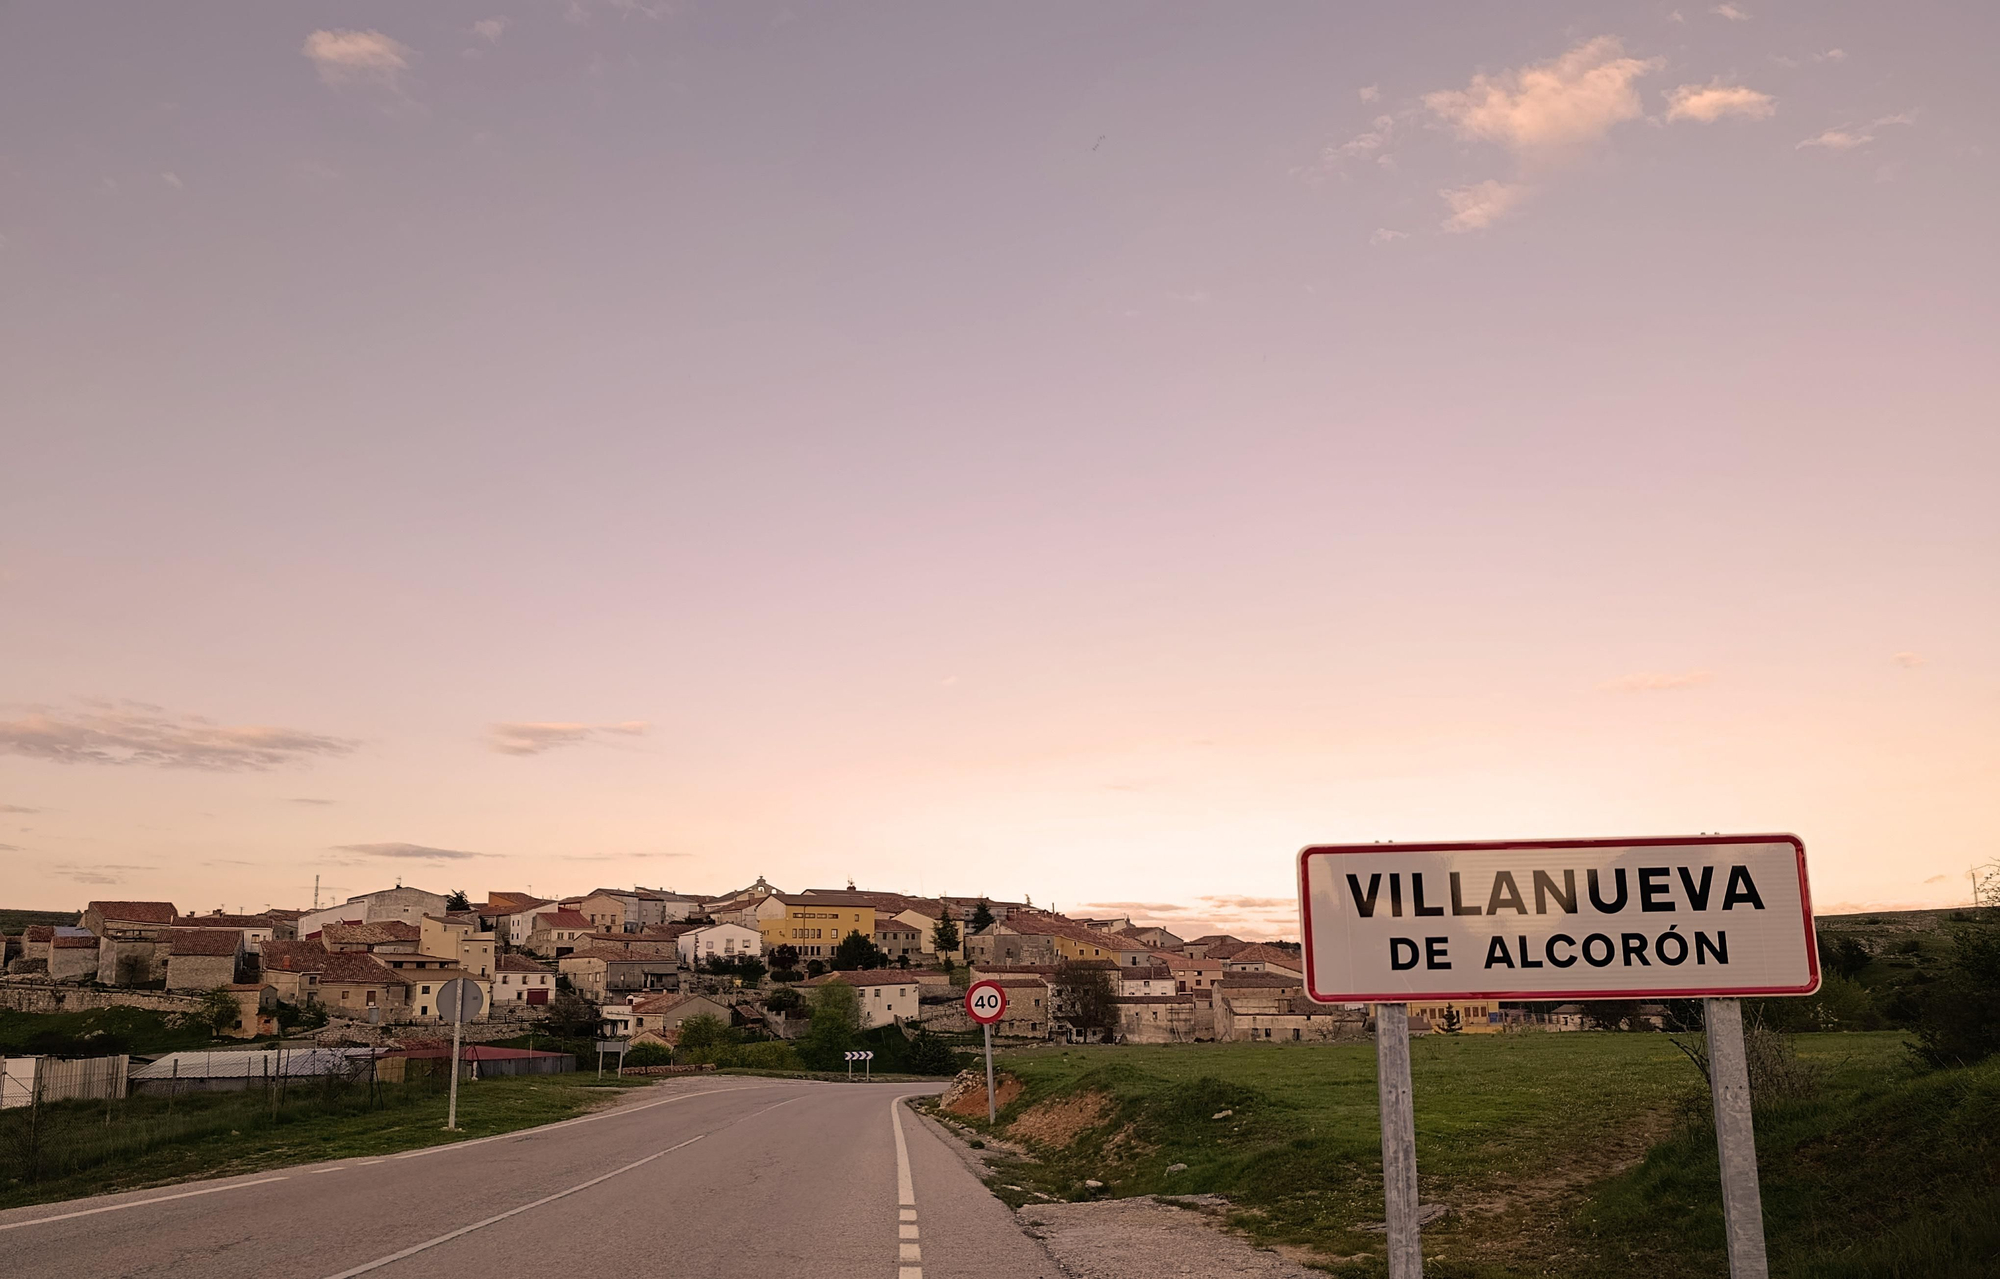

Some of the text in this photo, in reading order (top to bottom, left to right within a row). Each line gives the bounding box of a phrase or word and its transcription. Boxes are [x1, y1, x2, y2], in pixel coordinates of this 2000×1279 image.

[1346, 865, 1765, 918] VILLANUEVA
[1390, 924, 1730, 971] DE ALCORÓN
[974, 994, 999, 1009] 40
